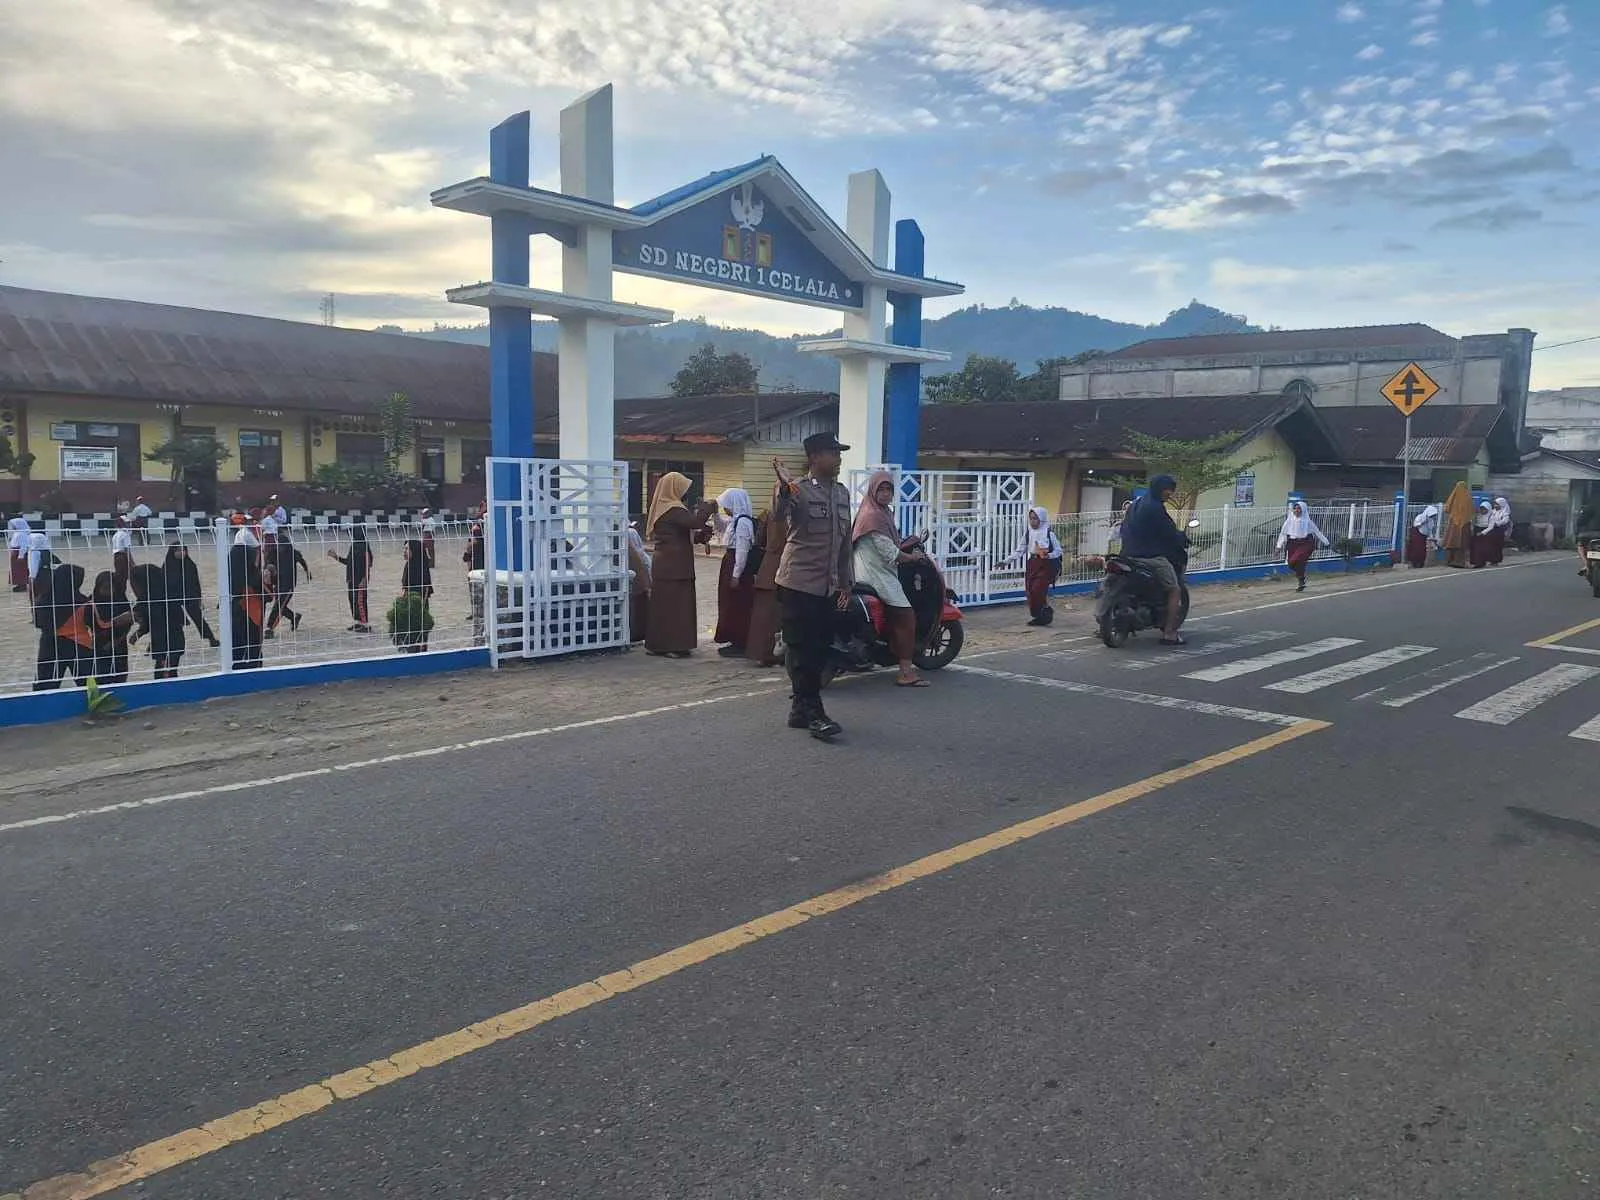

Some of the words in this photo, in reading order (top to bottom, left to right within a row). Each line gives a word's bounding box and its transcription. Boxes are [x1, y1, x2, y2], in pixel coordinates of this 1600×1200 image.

[639, 244, 668, 266] SD
[675, 251, 751, 283] NEGERI
[757, 267, 766, 283] 1
[769, 271, 839, 299] CELALA
